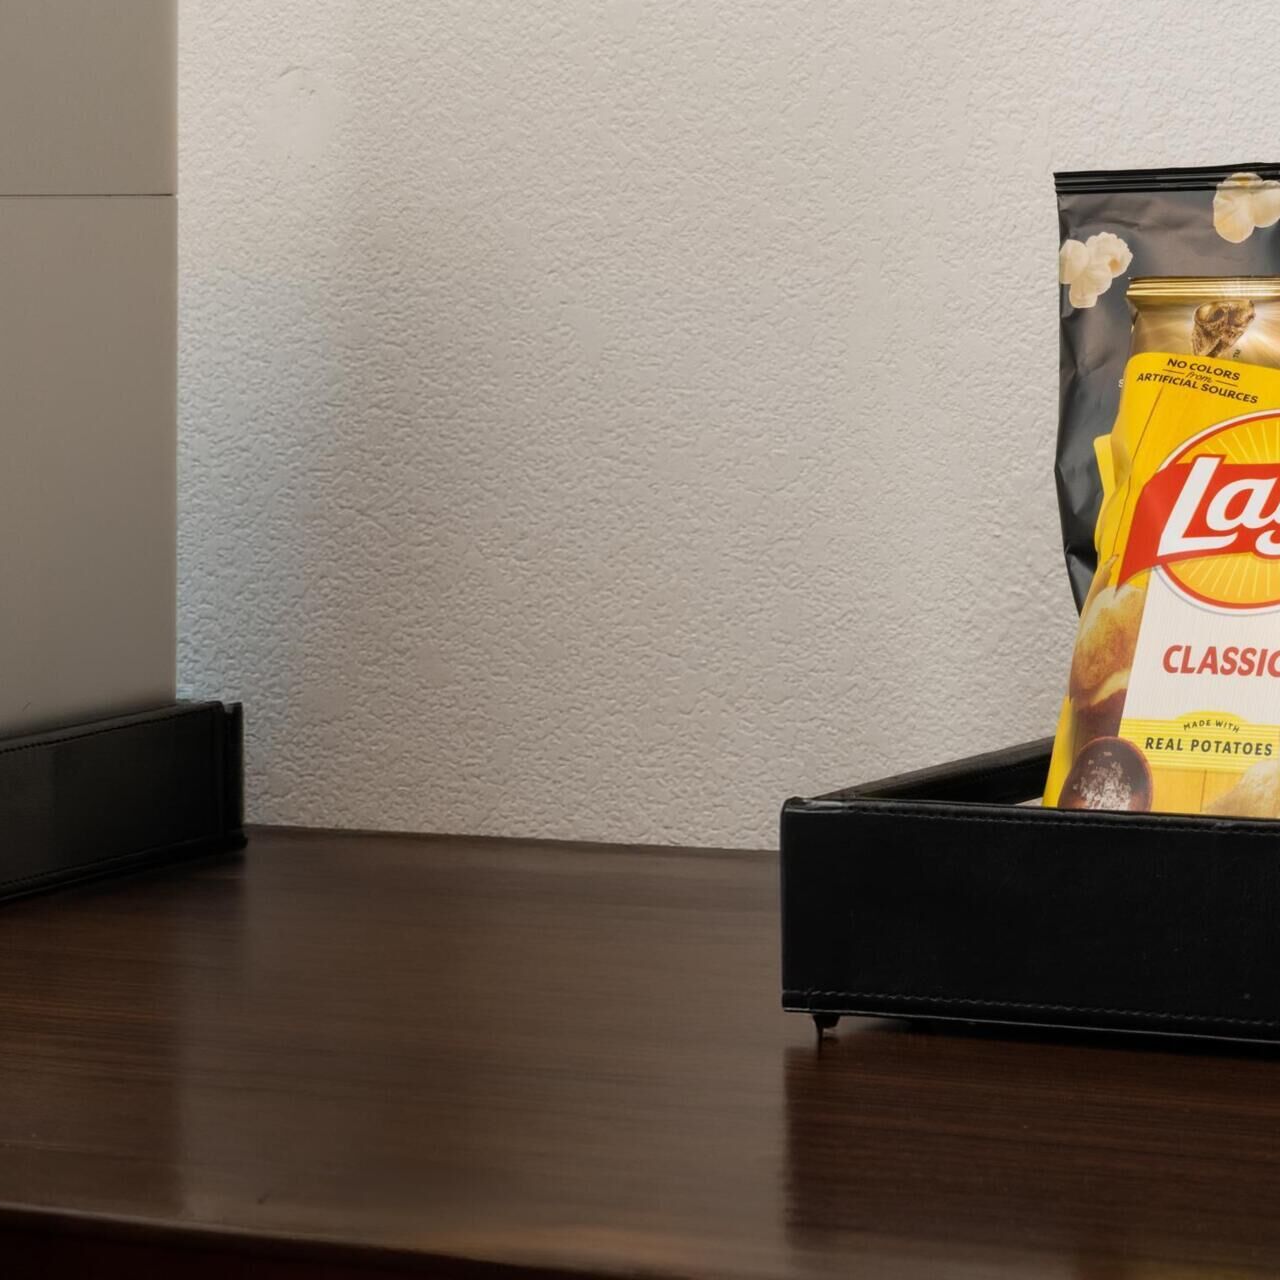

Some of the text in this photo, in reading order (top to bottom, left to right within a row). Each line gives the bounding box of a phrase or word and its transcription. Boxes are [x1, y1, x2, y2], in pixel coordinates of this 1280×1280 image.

[1167, 357, 1241, 381] NO COLORS
[1185, 371, 1213, 384] from
[1136, 373, 1198, 389] ARTIFICIAL
[1201, 383, 1258, 404] SOURCES
[1183, 719, 1240, 733] MADE WITH
[1145, 737, 1273, 756] REAL POTATOES
